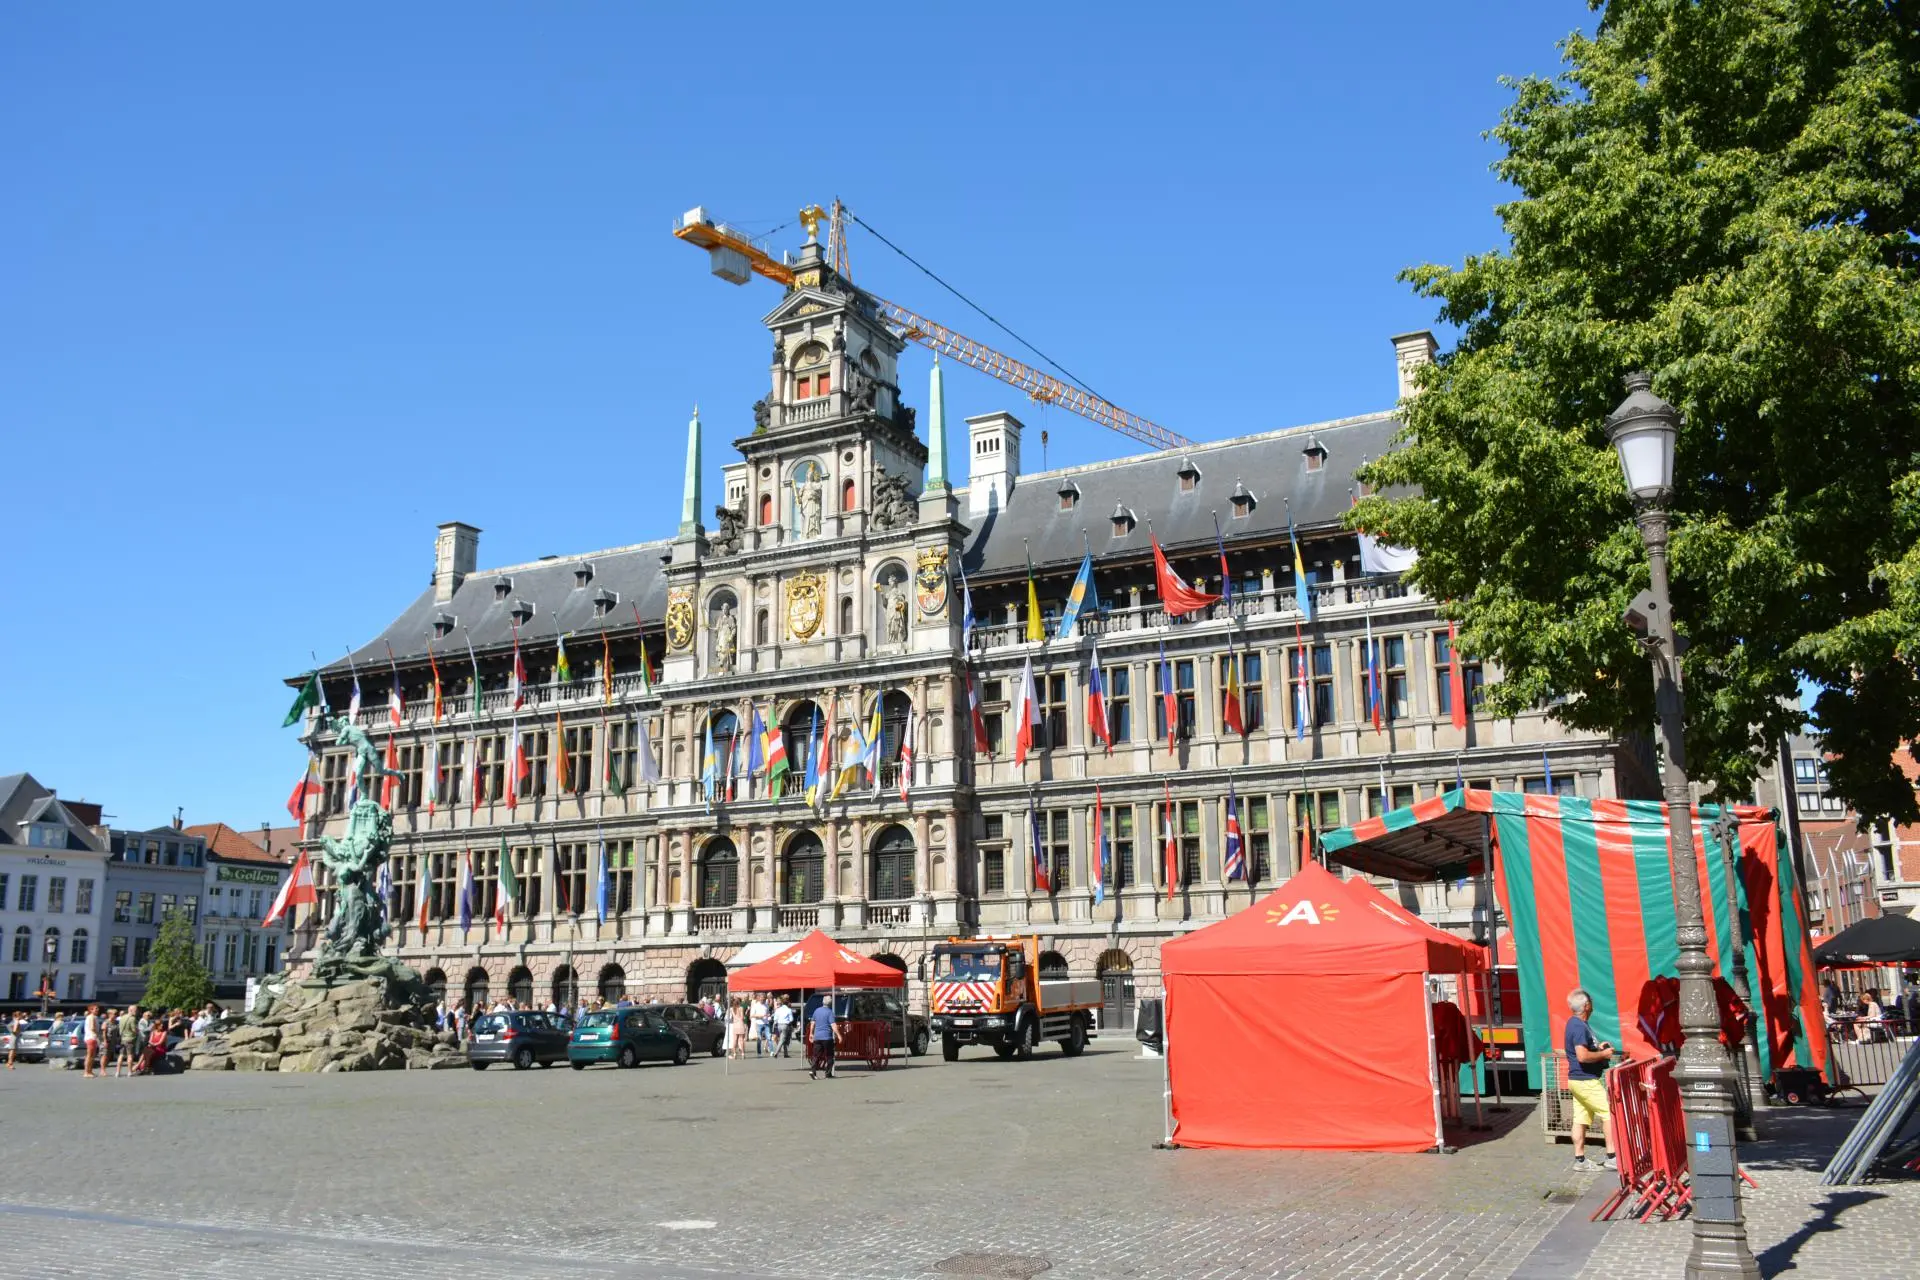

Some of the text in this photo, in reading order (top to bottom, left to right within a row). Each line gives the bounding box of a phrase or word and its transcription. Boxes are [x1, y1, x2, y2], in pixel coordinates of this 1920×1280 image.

[234, 868, 278, 883] Gollem
[1277, 899, 1321, 926] A
[782, 950, 804, 965] A
